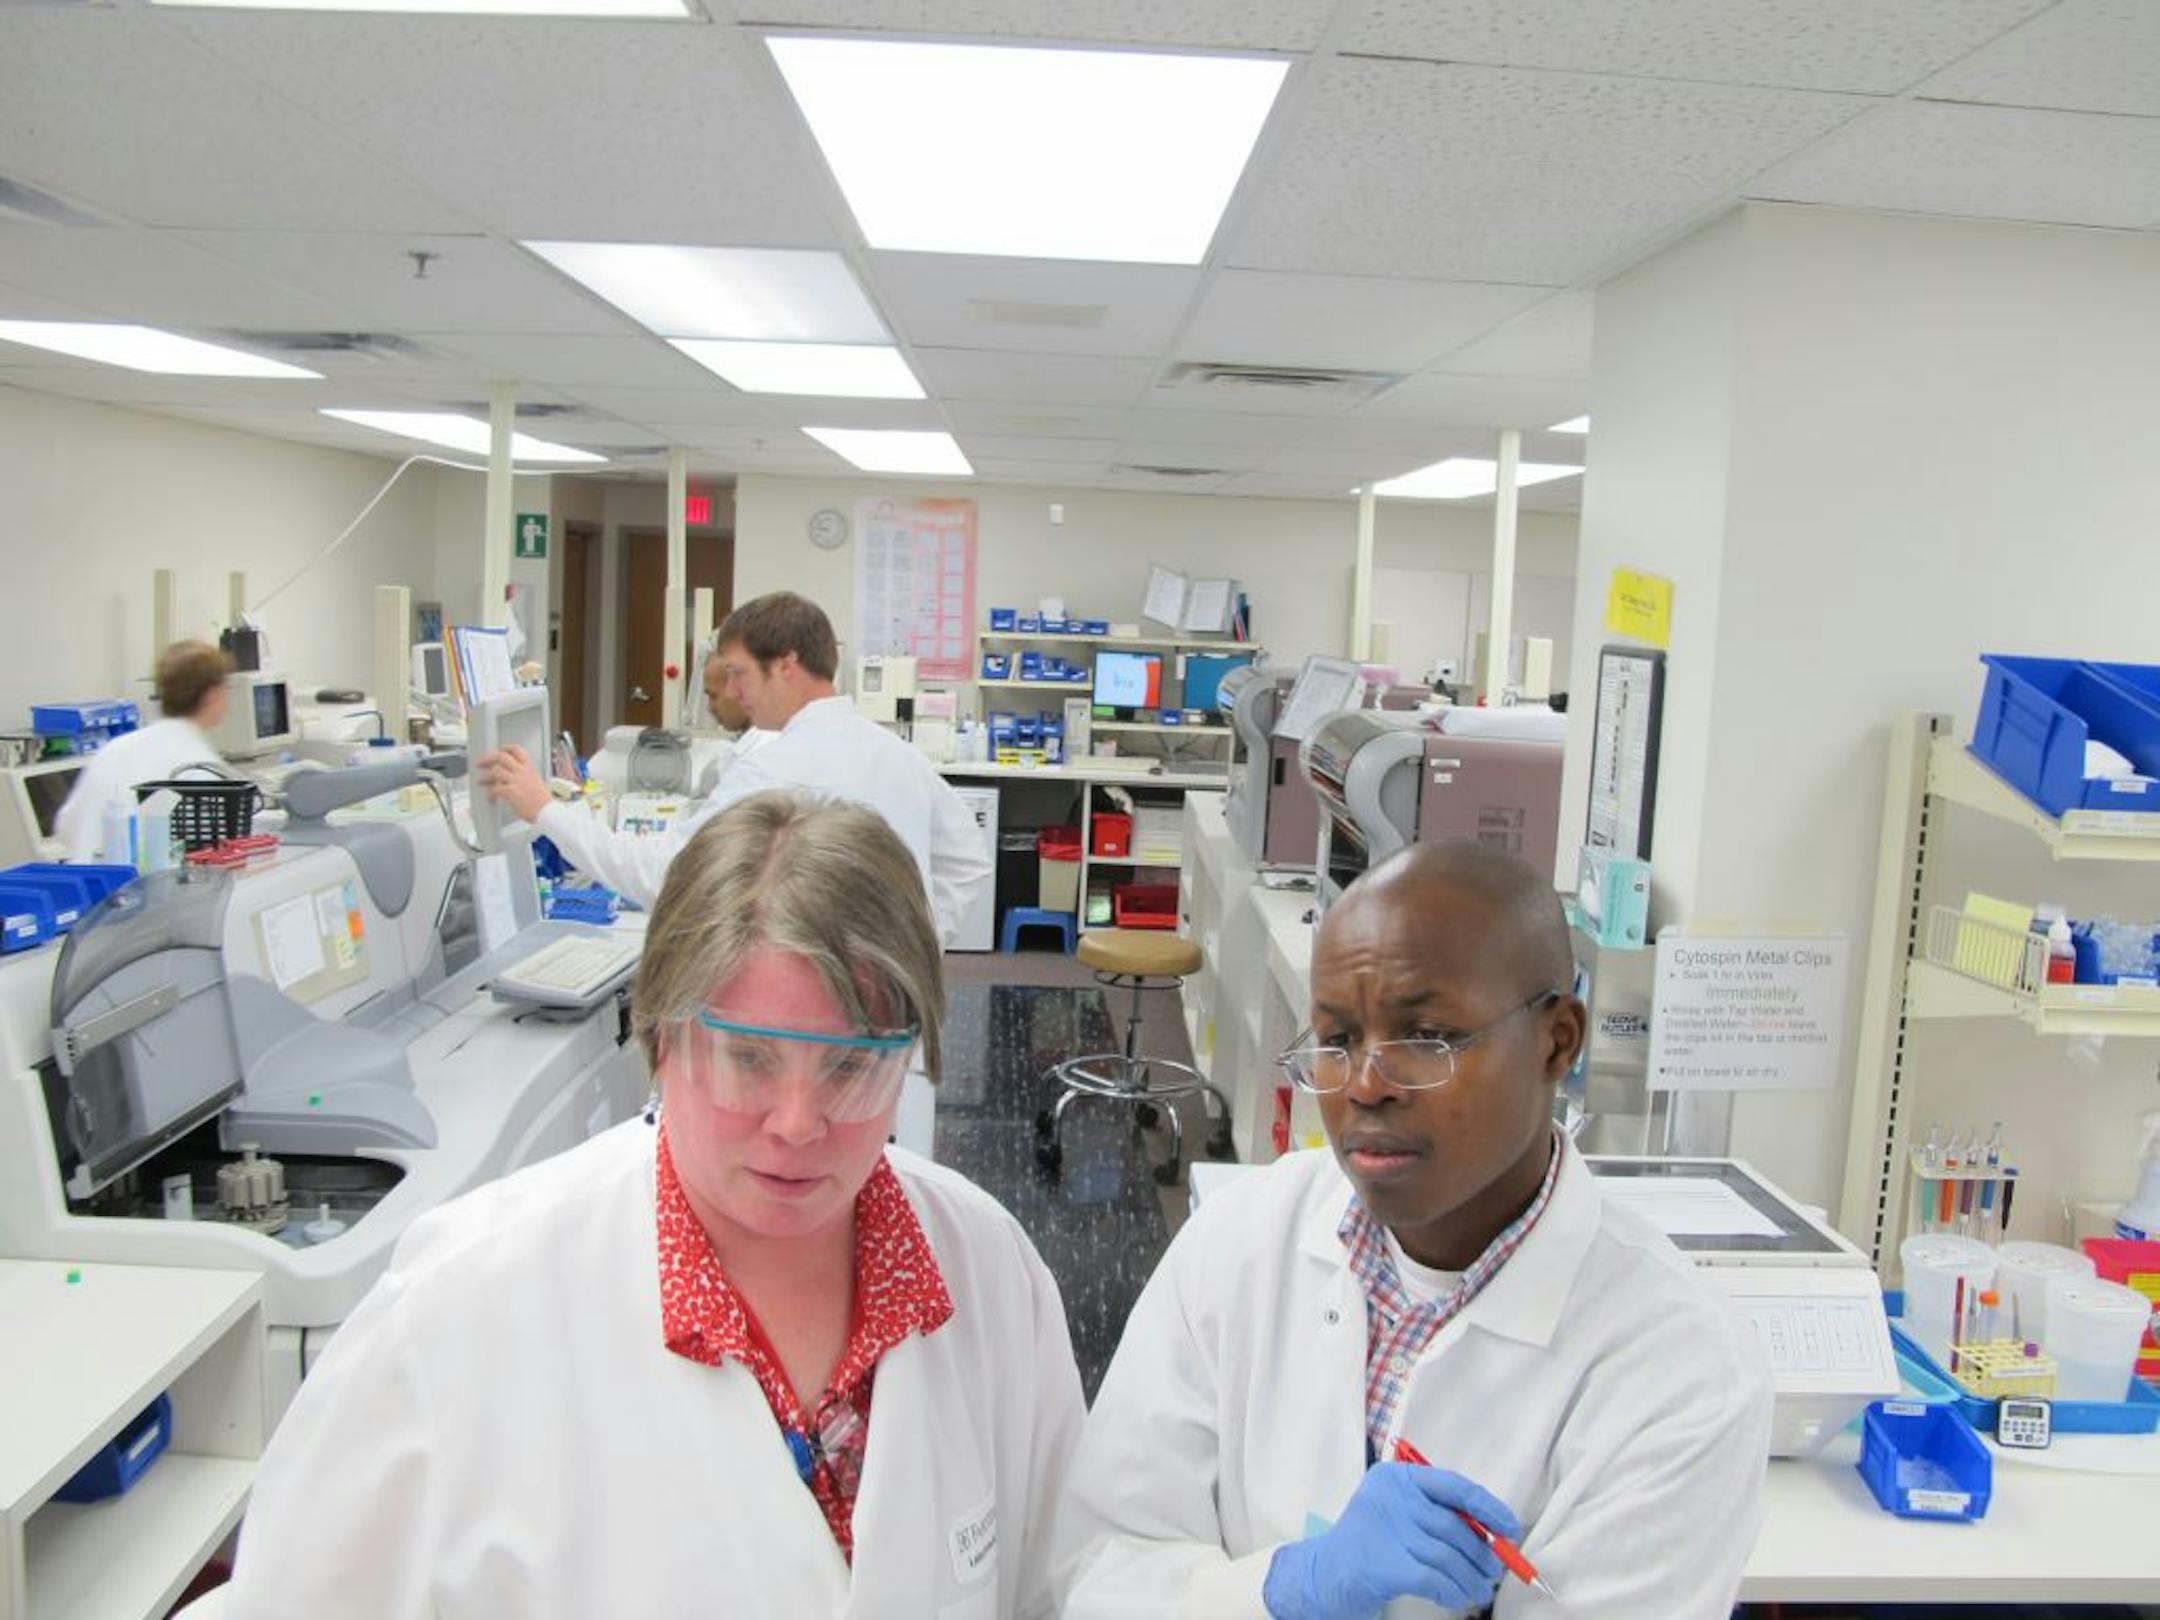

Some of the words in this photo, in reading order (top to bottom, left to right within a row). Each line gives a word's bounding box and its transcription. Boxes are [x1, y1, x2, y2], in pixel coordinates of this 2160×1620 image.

[1674, 948, 1742, 968] Cytospin
[1746, 949, 1789, 965] Metal
[1794, 950, 1832, 968] Clips
[1706, 985, 1799, 1002] Immediately
